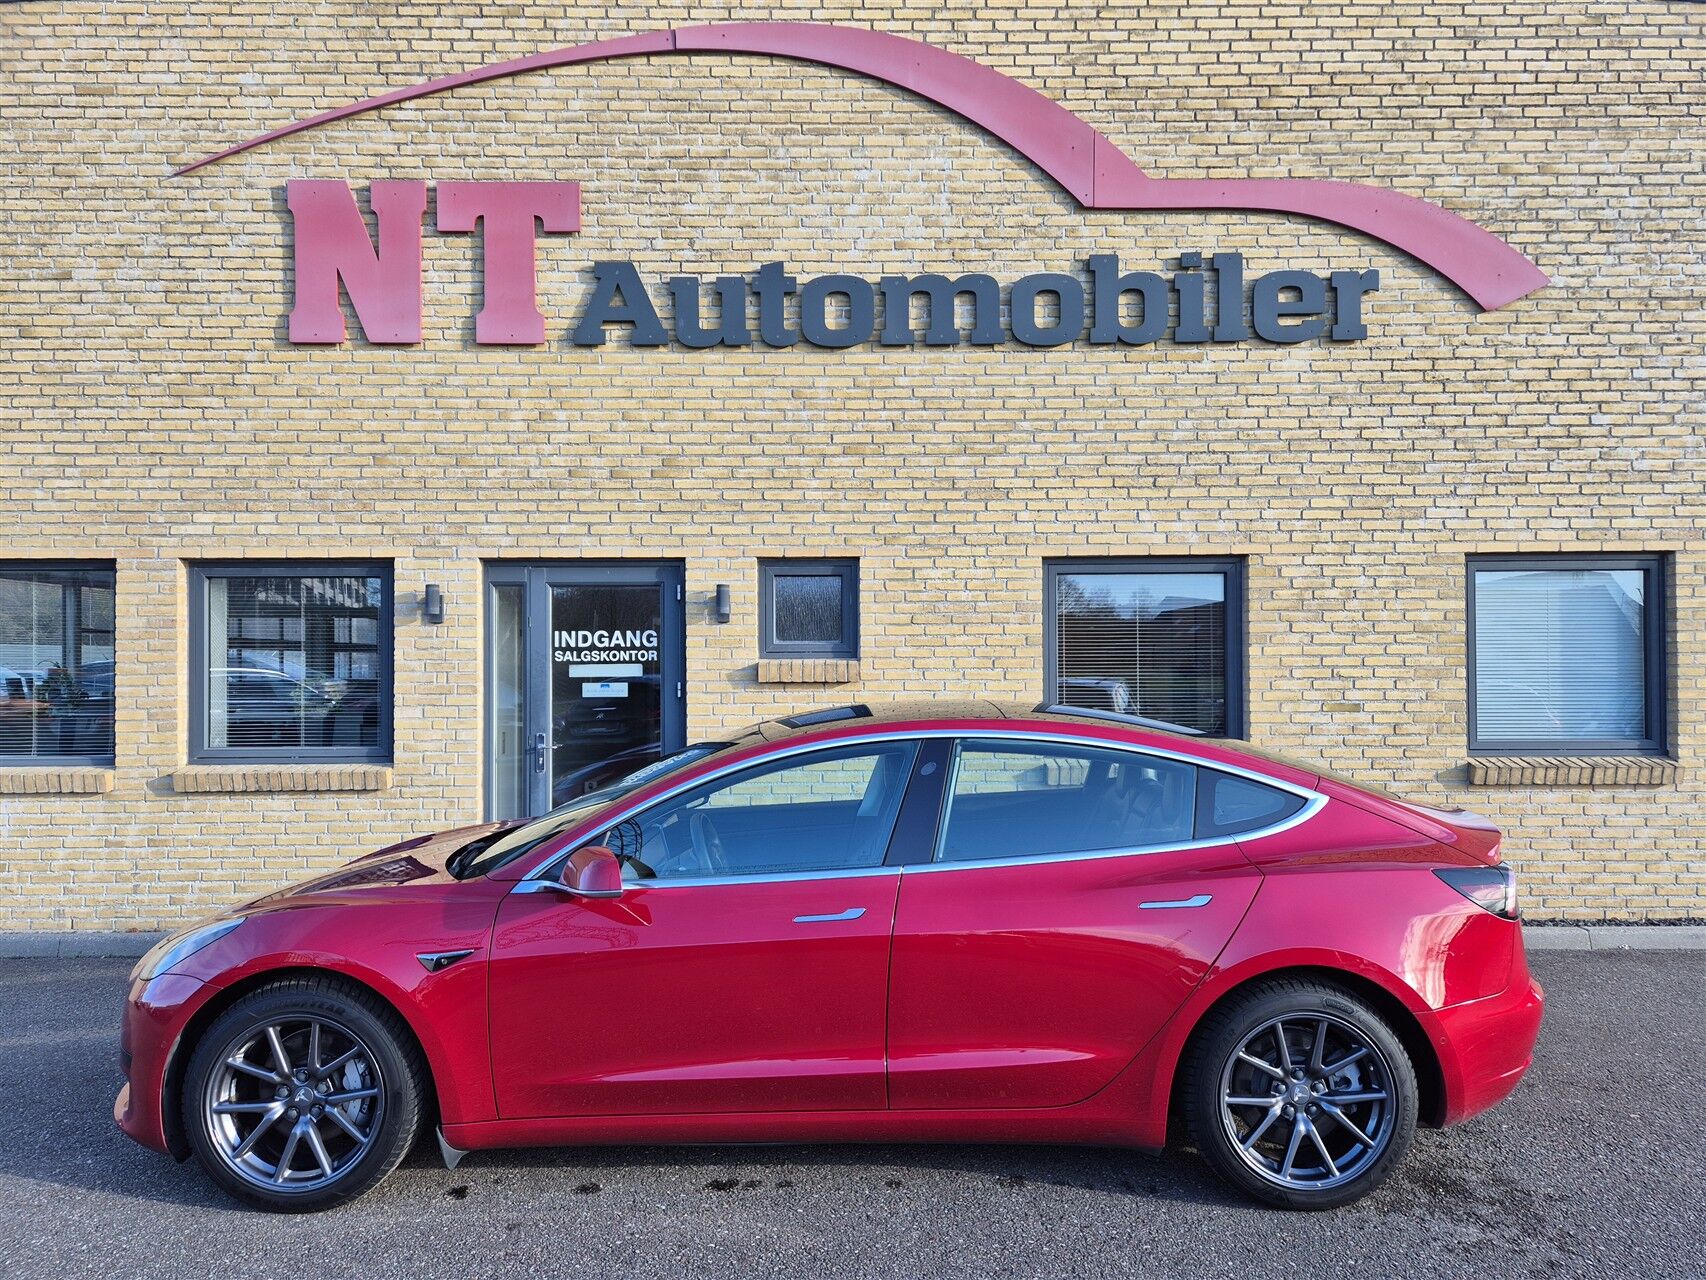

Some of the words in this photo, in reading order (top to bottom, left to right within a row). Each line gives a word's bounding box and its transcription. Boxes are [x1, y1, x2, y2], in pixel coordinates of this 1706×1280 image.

[287, 179, 580, 344] NT
[576, 253, 1379, 348] Automobiler
[554, 630, 658, 648] INDGANG
[554, 650, 658, 662] SALGSKONTOR
